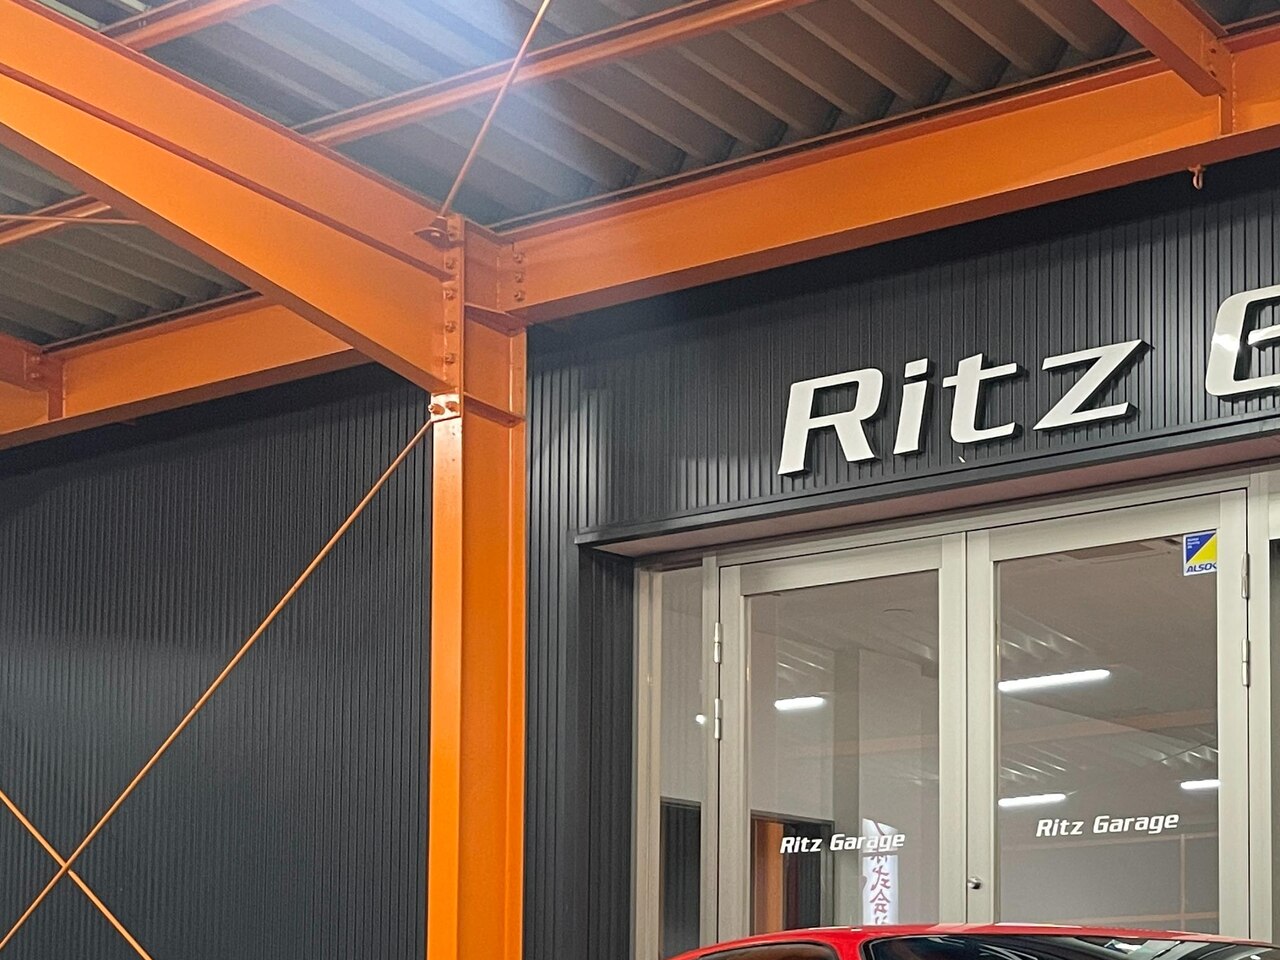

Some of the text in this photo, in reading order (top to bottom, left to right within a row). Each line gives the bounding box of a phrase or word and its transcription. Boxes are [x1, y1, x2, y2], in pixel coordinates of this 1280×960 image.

[777, 339, 1143, 476] Ritz
[1035, 814, 1180, 838] Ritz Garage
[779, 833, 906, 854] Ritz Garage
